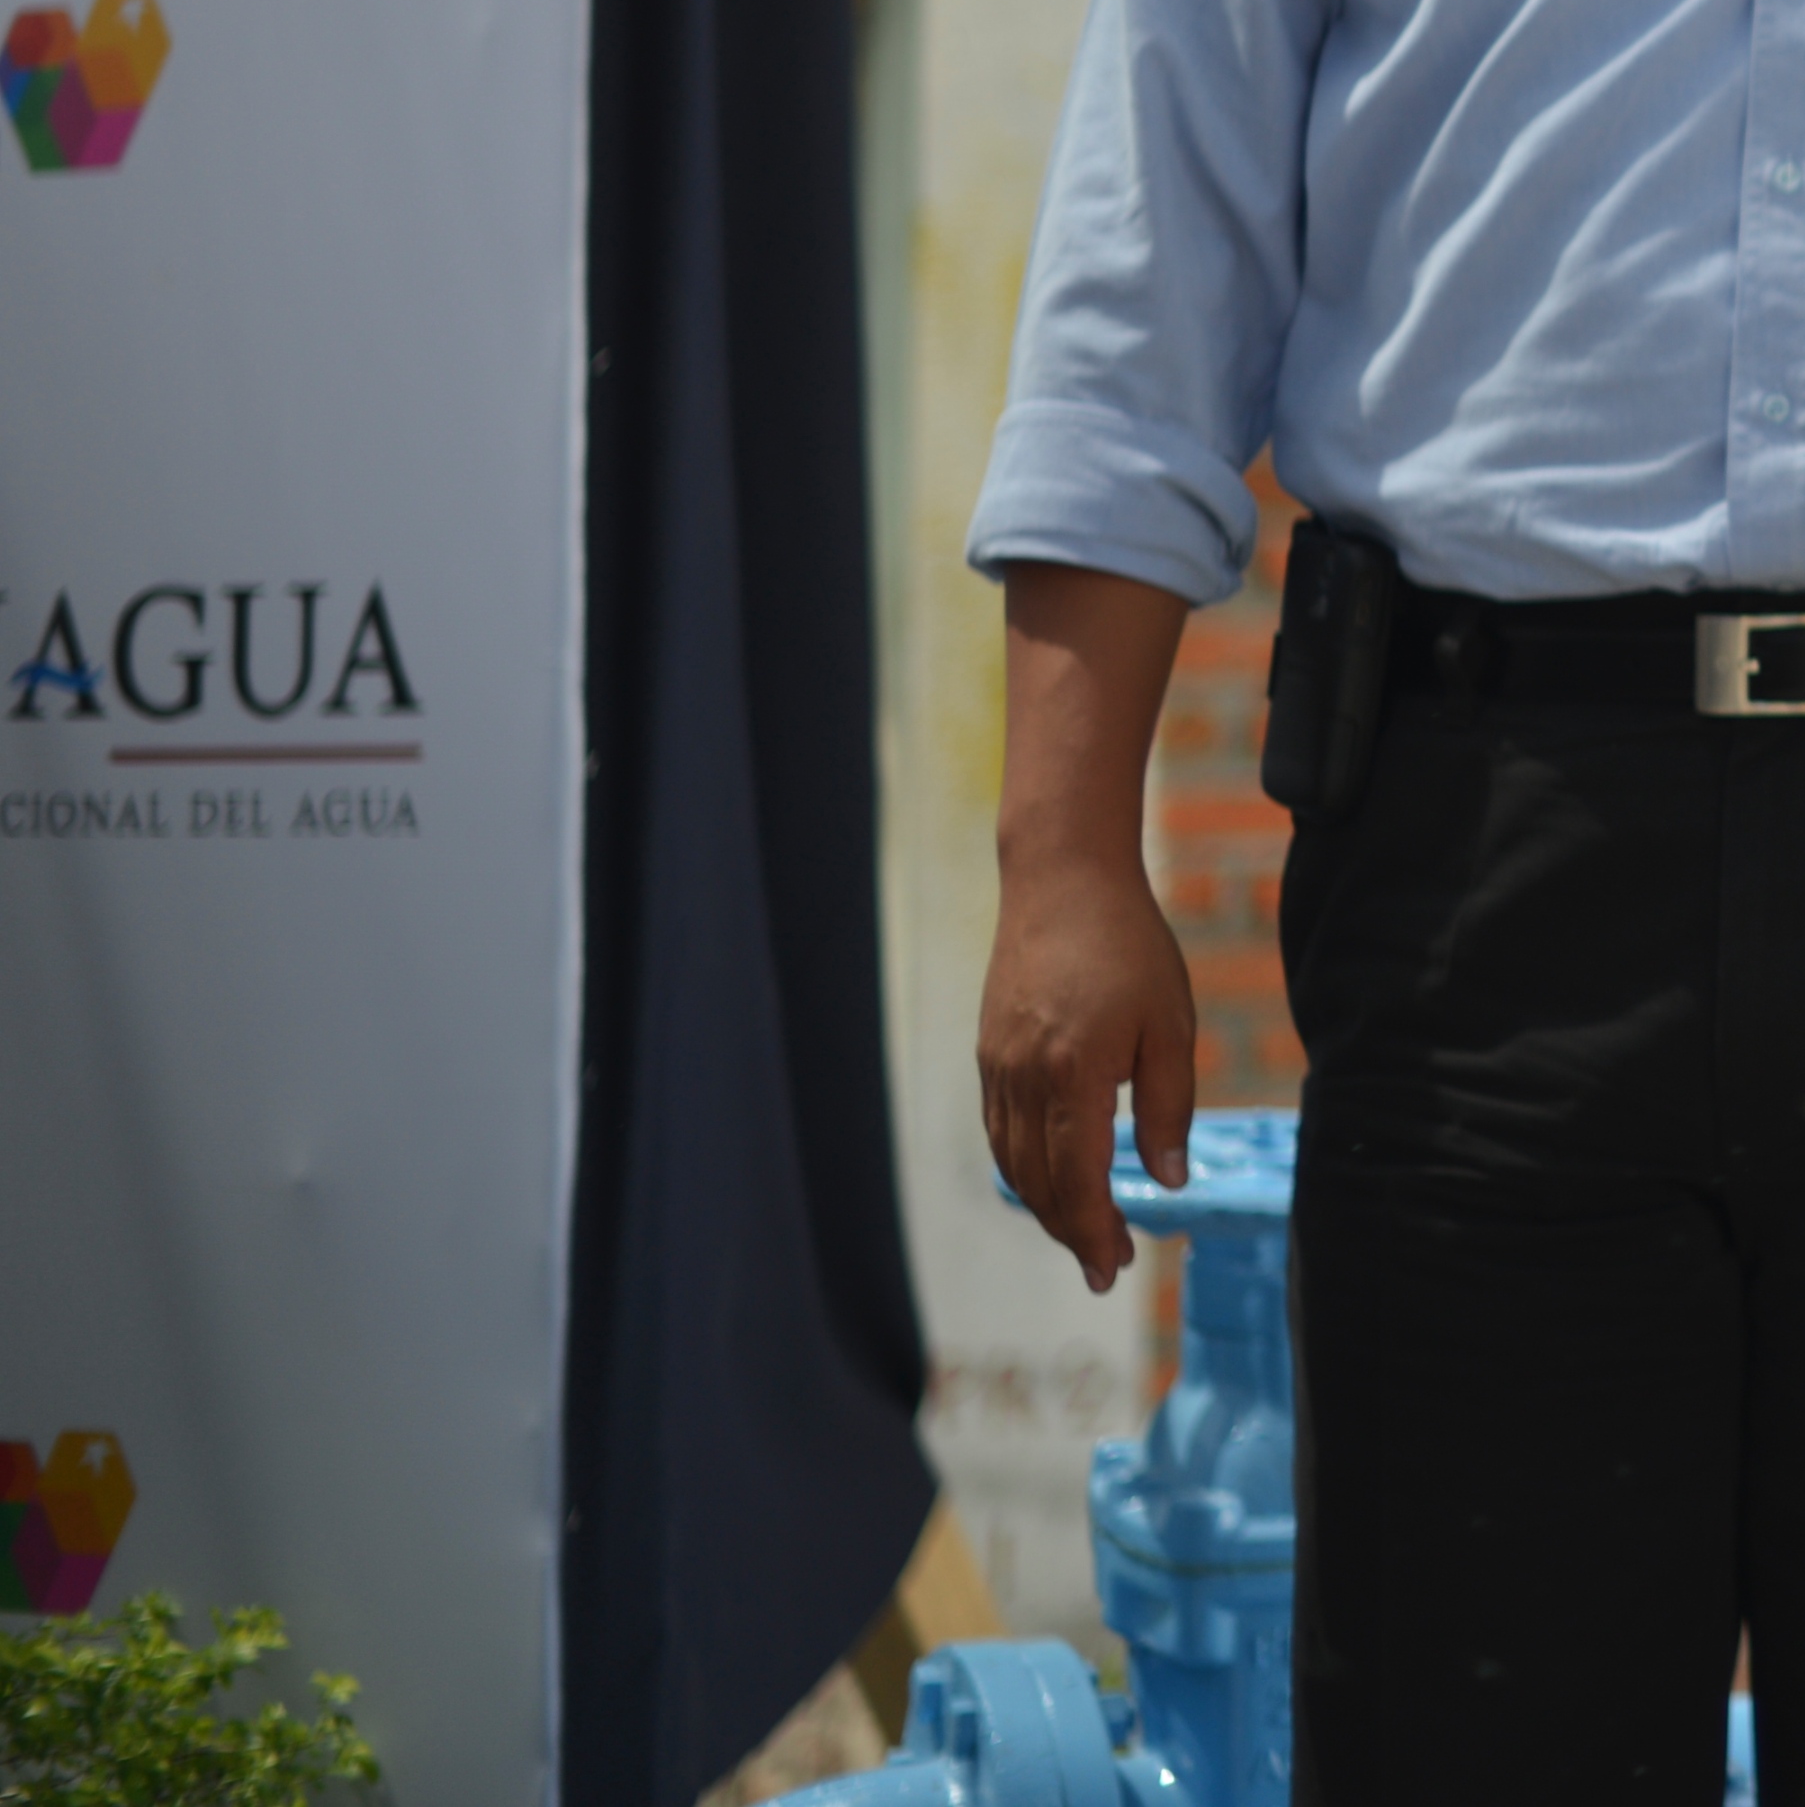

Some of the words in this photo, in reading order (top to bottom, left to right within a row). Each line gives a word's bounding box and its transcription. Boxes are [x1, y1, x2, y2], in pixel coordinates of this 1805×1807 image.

[0, 579, 424, 723] AGUA
[188, 787, 274, 839] DEL
[287, 786, 420, 839] AGUA
